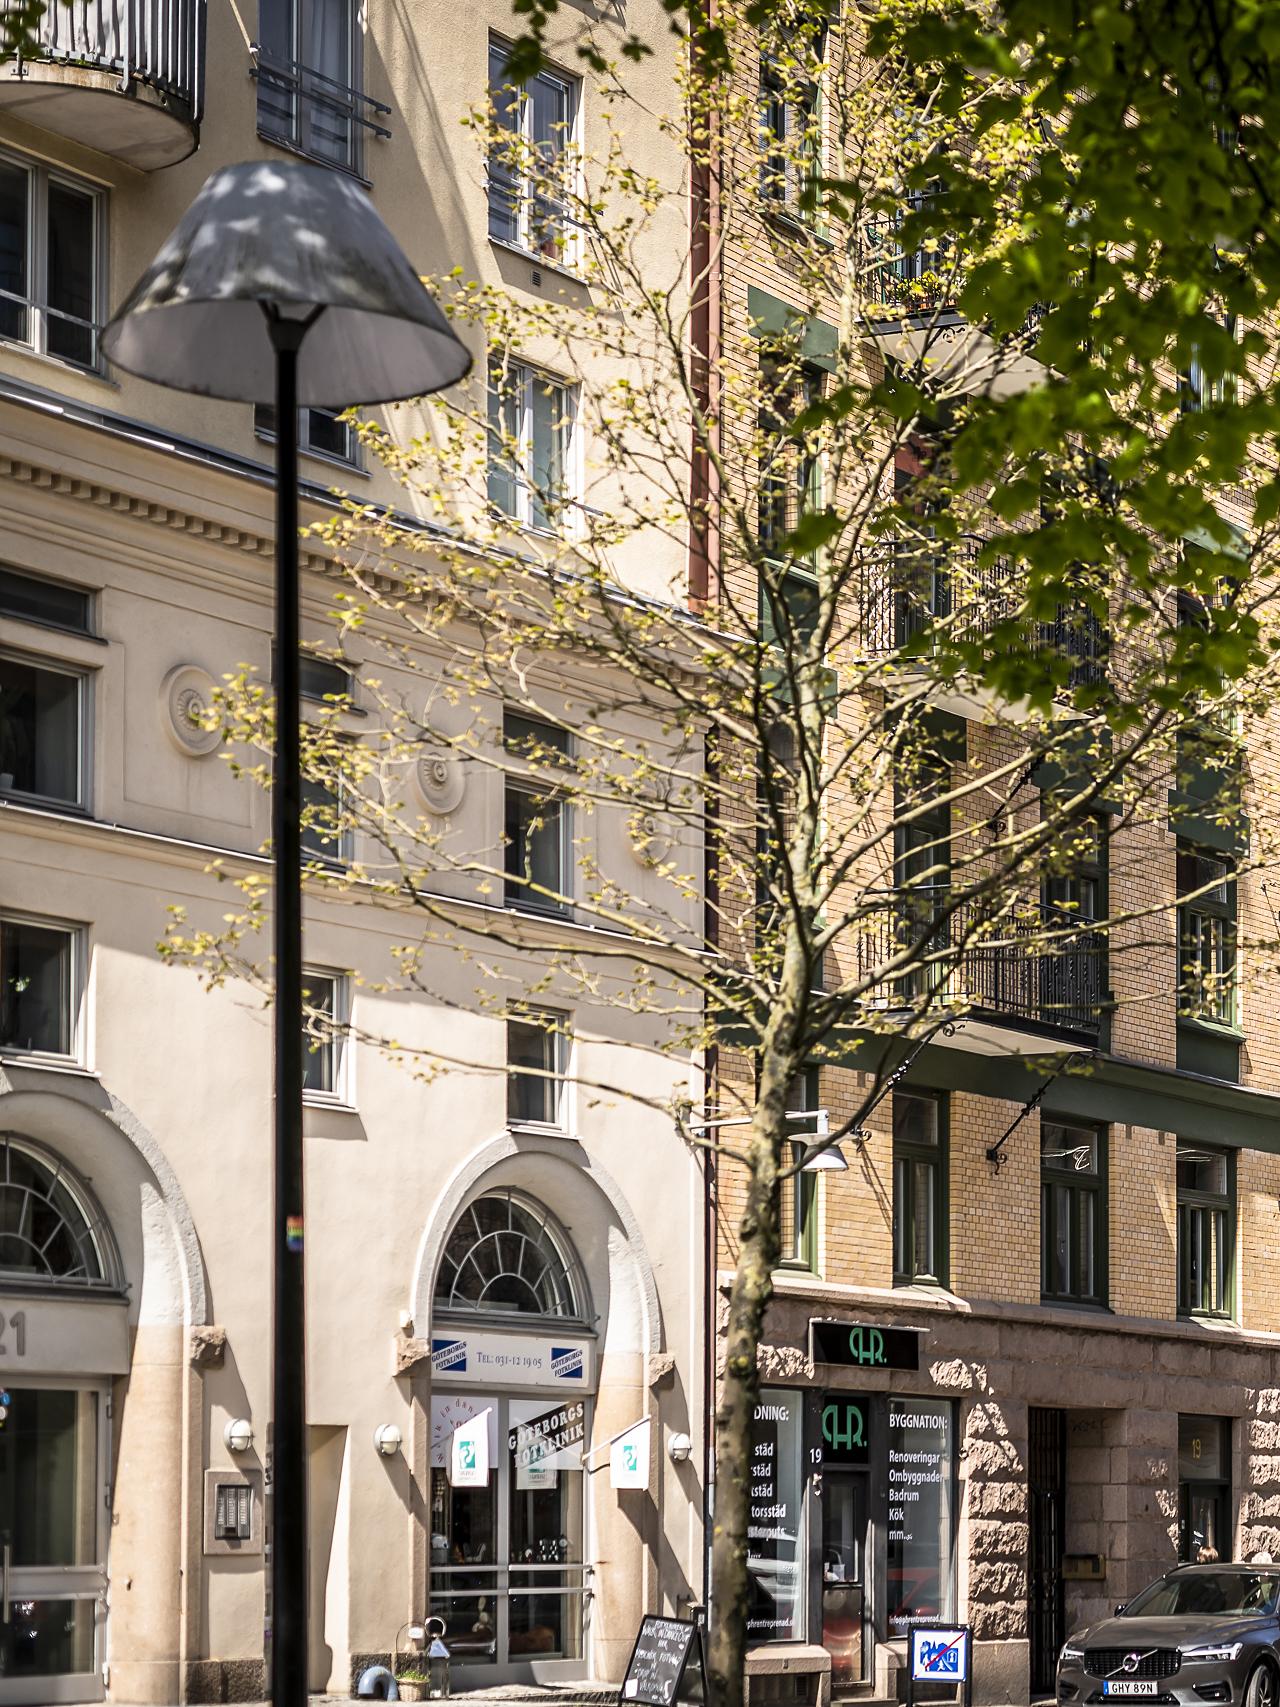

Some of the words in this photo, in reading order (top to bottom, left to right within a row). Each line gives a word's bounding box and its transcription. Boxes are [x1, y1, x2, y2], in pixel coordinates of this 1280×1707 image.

[0, 1310, 26, 1357] 1
[431, 1341, 467, 1362] GÖTEBORGS
[435, 1351, 466, 1370] FOTKLINIK
[495, 1356, 520, 1368] 031-12
[551, 1350, 583, 1370] GÖTEBORGS
[555, 1359, 582, 1377] FOTKLINIK
[753, 1405, 789, 1421] DNING:
[889, 1413, 948, 1429] BYGGNATION:
[508, 1402, 584, 1449] GÖTEBORGS
[754, 1443, 774, 1457] städ
[809, 1448, 822, 1464] 19
[1192, 1438, 1201, 1459] 19
[889, 1450, 940, 1467] Renoveringar
[751, 1463, 772, 1477] städ
[888, 1469, 944, 1486] Ombyggnader
[889, 1489, 920, 1501] Badrum
[751, 1503, 787, 1518] torsstäd
[888, 1508, 905, 1521] Kök
[1112, 1684, 1130, 1693] GHY
[1134, 1684, 1153, 1693] 89N
